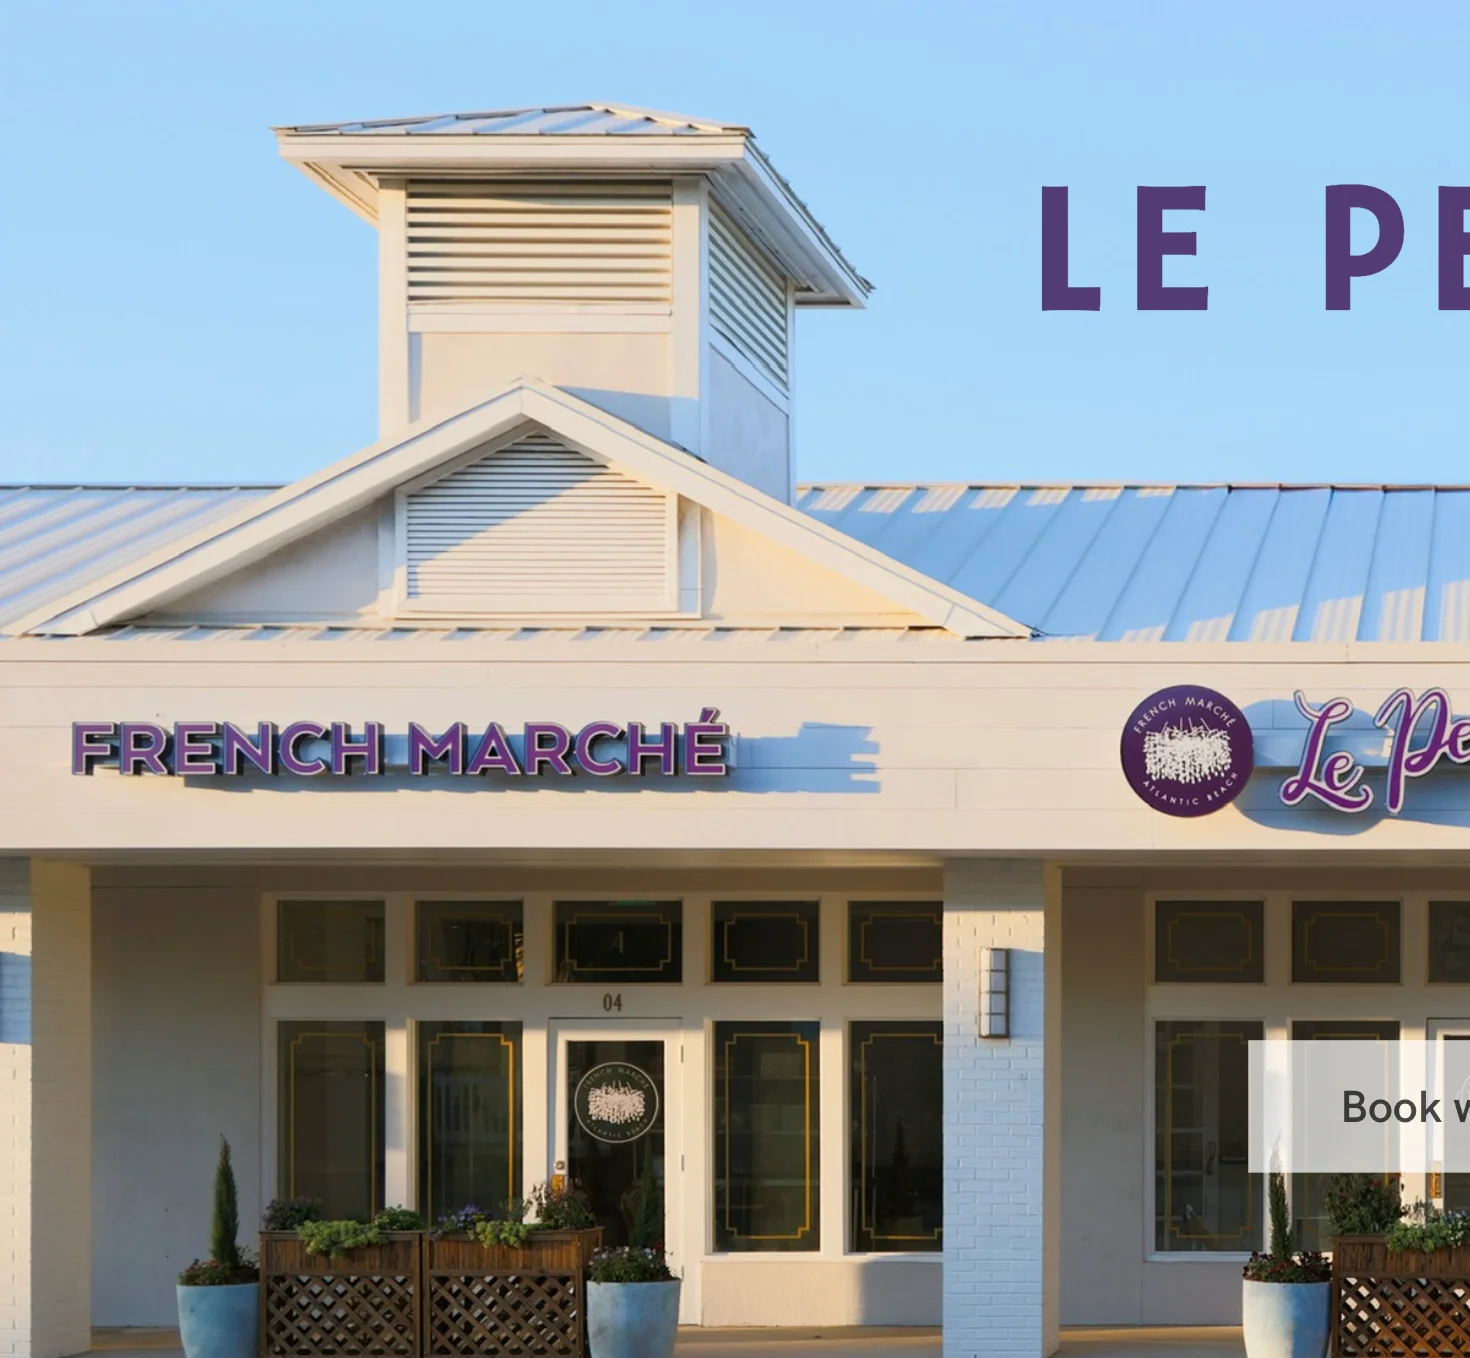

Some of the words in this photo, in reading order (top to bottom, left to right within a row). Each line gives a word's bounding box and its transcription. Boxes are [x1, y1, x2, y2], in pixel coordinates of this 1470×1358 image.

[1133, 698, 1177, 734] FRENCH
[1184, 697, 1237, 728] MARCHÉ
[72, 721, 381, 777] FRENCH
[409, 707, 728, 777] MARCHÉ
[1279, 689, 1374, 813] Le
[1142, 780, 1200, 806] ATLANTIC
[1207, 772, 1239, 802] BEACH
[602, 993, 623, 1012] 04
